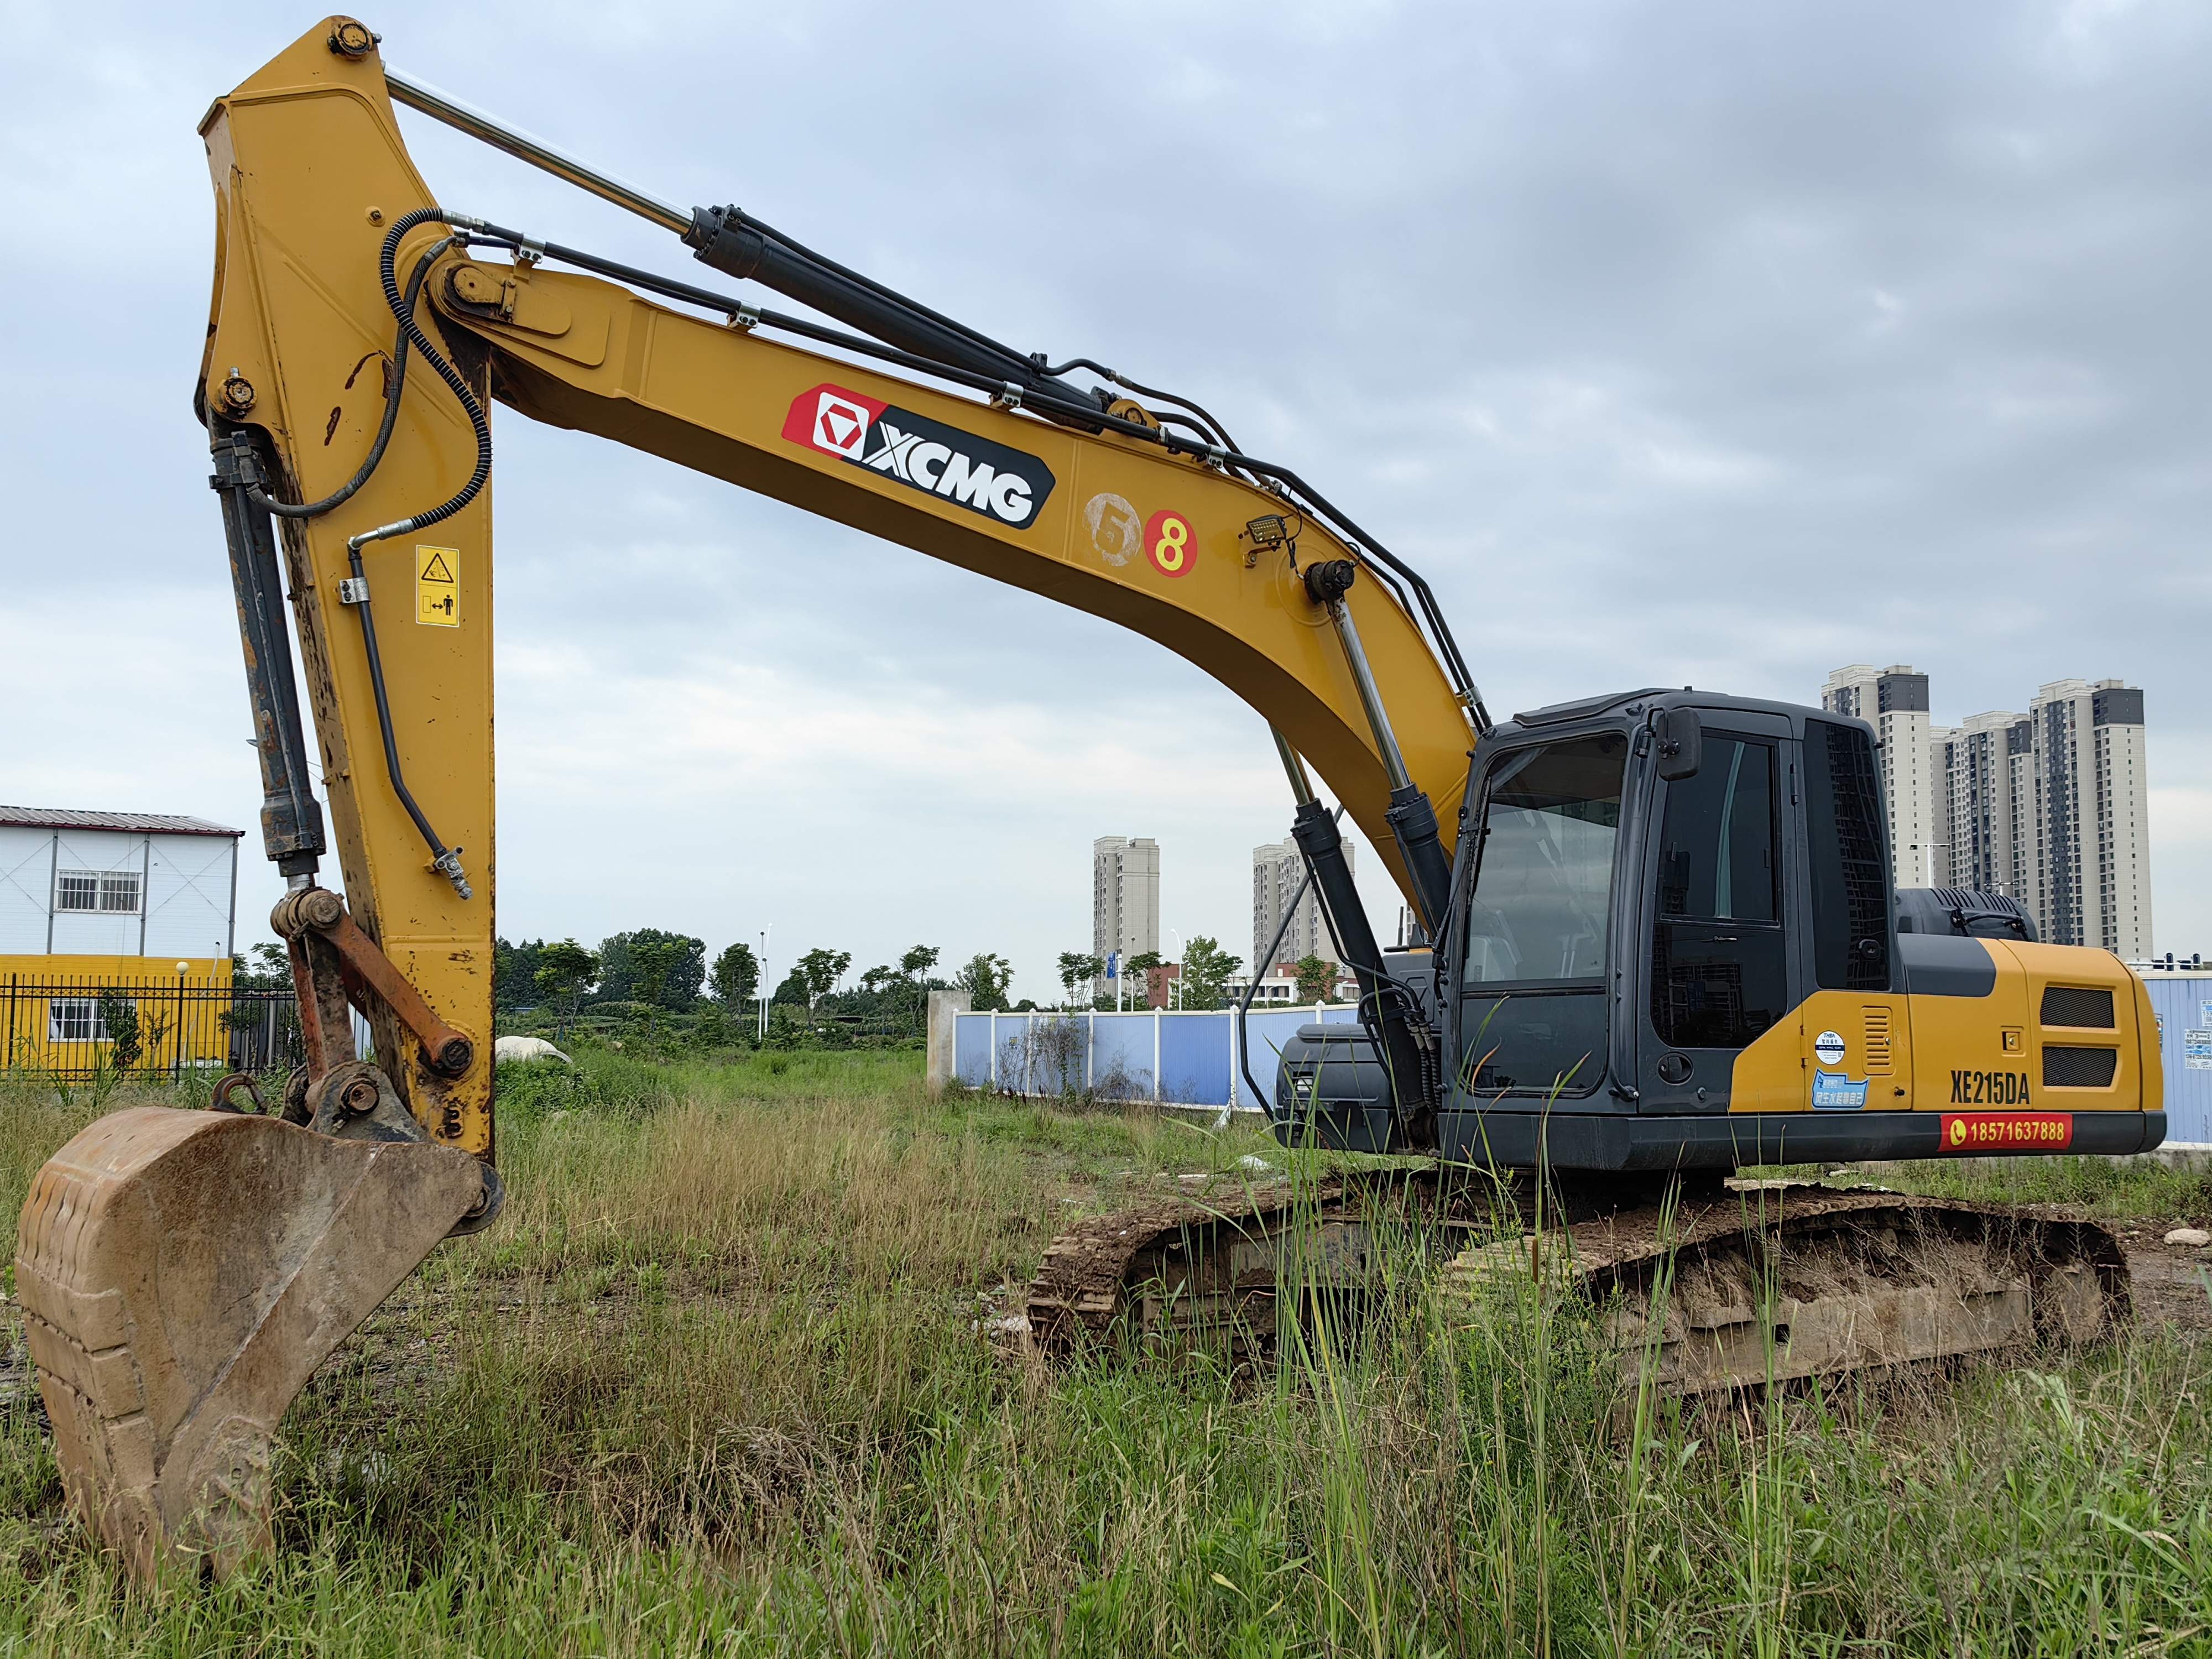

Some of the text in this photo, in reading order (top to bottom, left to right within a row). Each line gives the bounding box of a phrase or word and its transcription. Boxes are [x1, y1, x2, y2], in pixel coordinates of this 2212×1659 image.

[862, 421, 1033, 522] XCMG
[1156, 518, 1187, 571] 8
[1950, 1070, 2030, 1104] XE215DA
[1970, 1121, 2064, 1141] 18571637888
